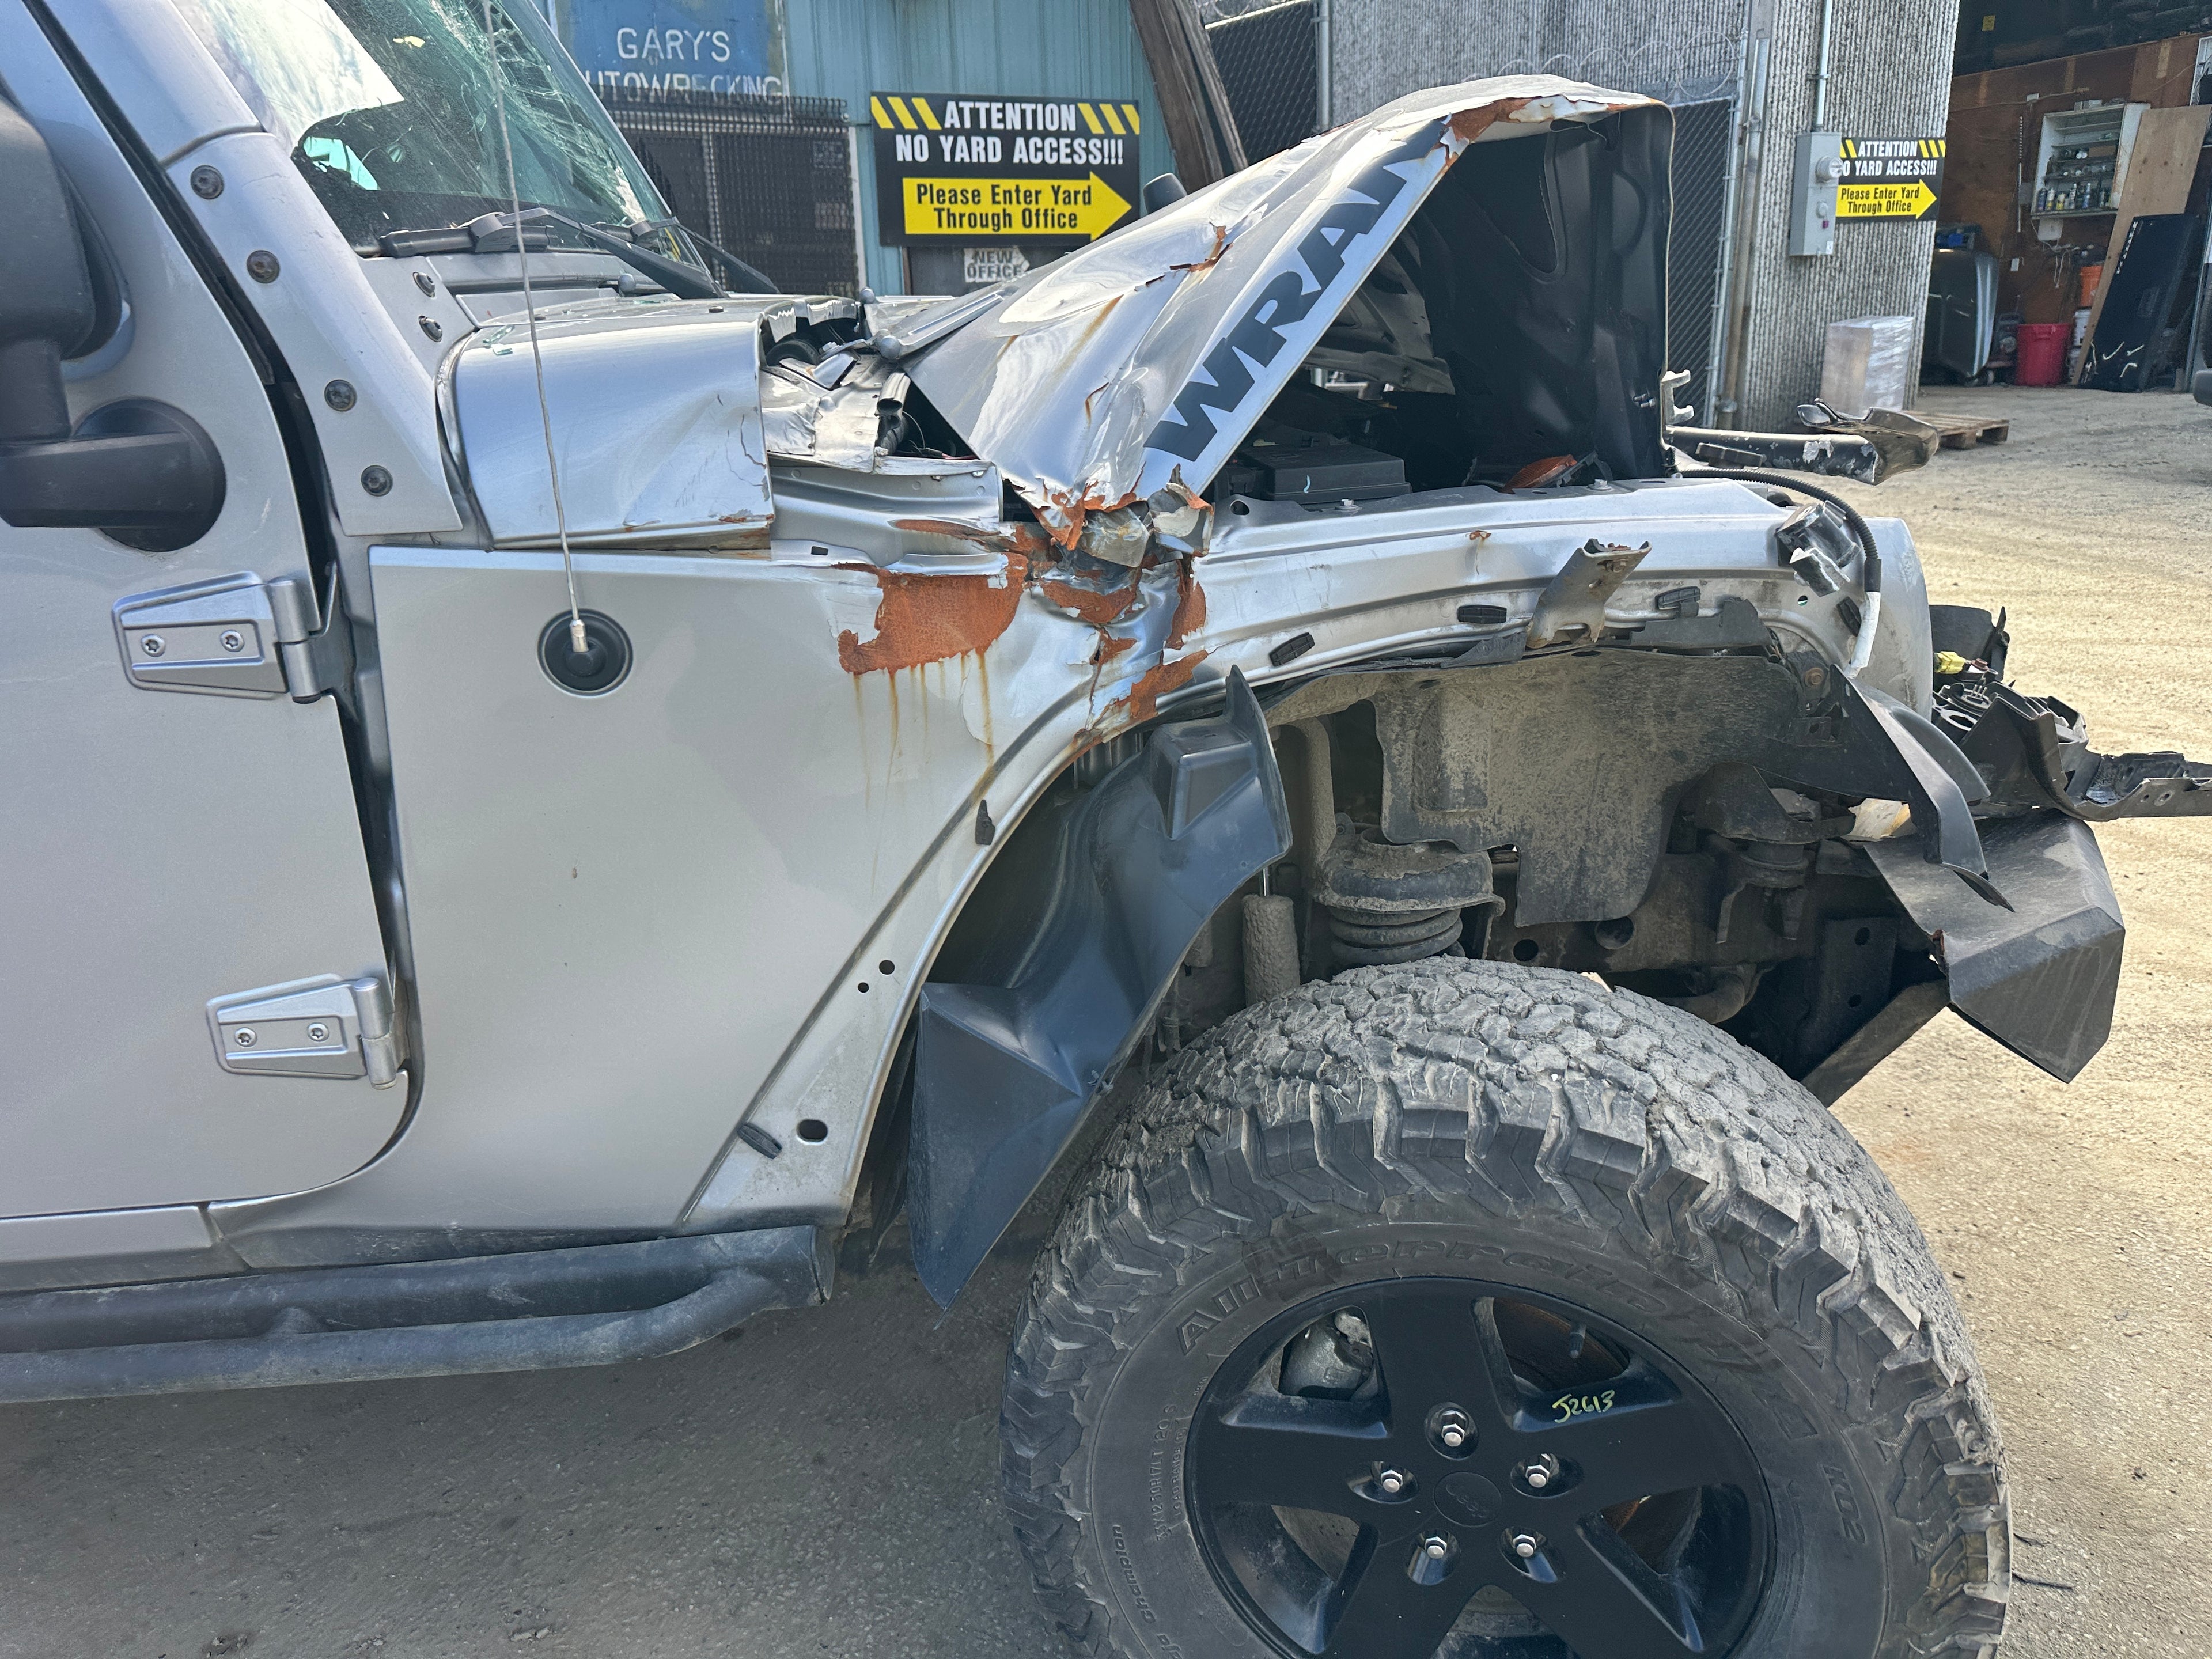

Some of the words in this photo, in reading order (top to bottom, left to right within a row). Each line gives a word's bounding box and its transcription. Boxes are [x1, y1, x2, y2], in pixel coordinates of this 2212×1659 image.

[617, 27, 730, 62] GARY'S
[944, 100, 1077, 131] ATTENTION
[896, 134, 929, 162] NO
[939, 135, 1002, 163] YARD
[1013, 136, 1124, 165] ACCESS!!!
[1858, 141, 1918, 157] ATTENTION
[1842, 160, 1850, 176] O
[1855, 160, 1883, 176] YARD
[1885, 160, 1937, 176] ACCESS!!!
[916, 183, 981, 204] Please
[991, 184, 1042, 205] Enter
[1051, 185, 1092, 206] Yard
[1840, 188, 1870, 200] Please
[1873, 187, 1897, 199] Enter
[1901, 187, 1919, 199] Yard
[1847, 201, 1882, 215] Through
[1885, 202, 1911, 213] Office
[934, 207, 1012, 232] Through
[1022, 207, 1078, 229] Office
[972, 250, 1013, 264] NEW
[967, 263, 1022, 278] OFFICE
[1112, 1524, 1156, 1624] Champion
